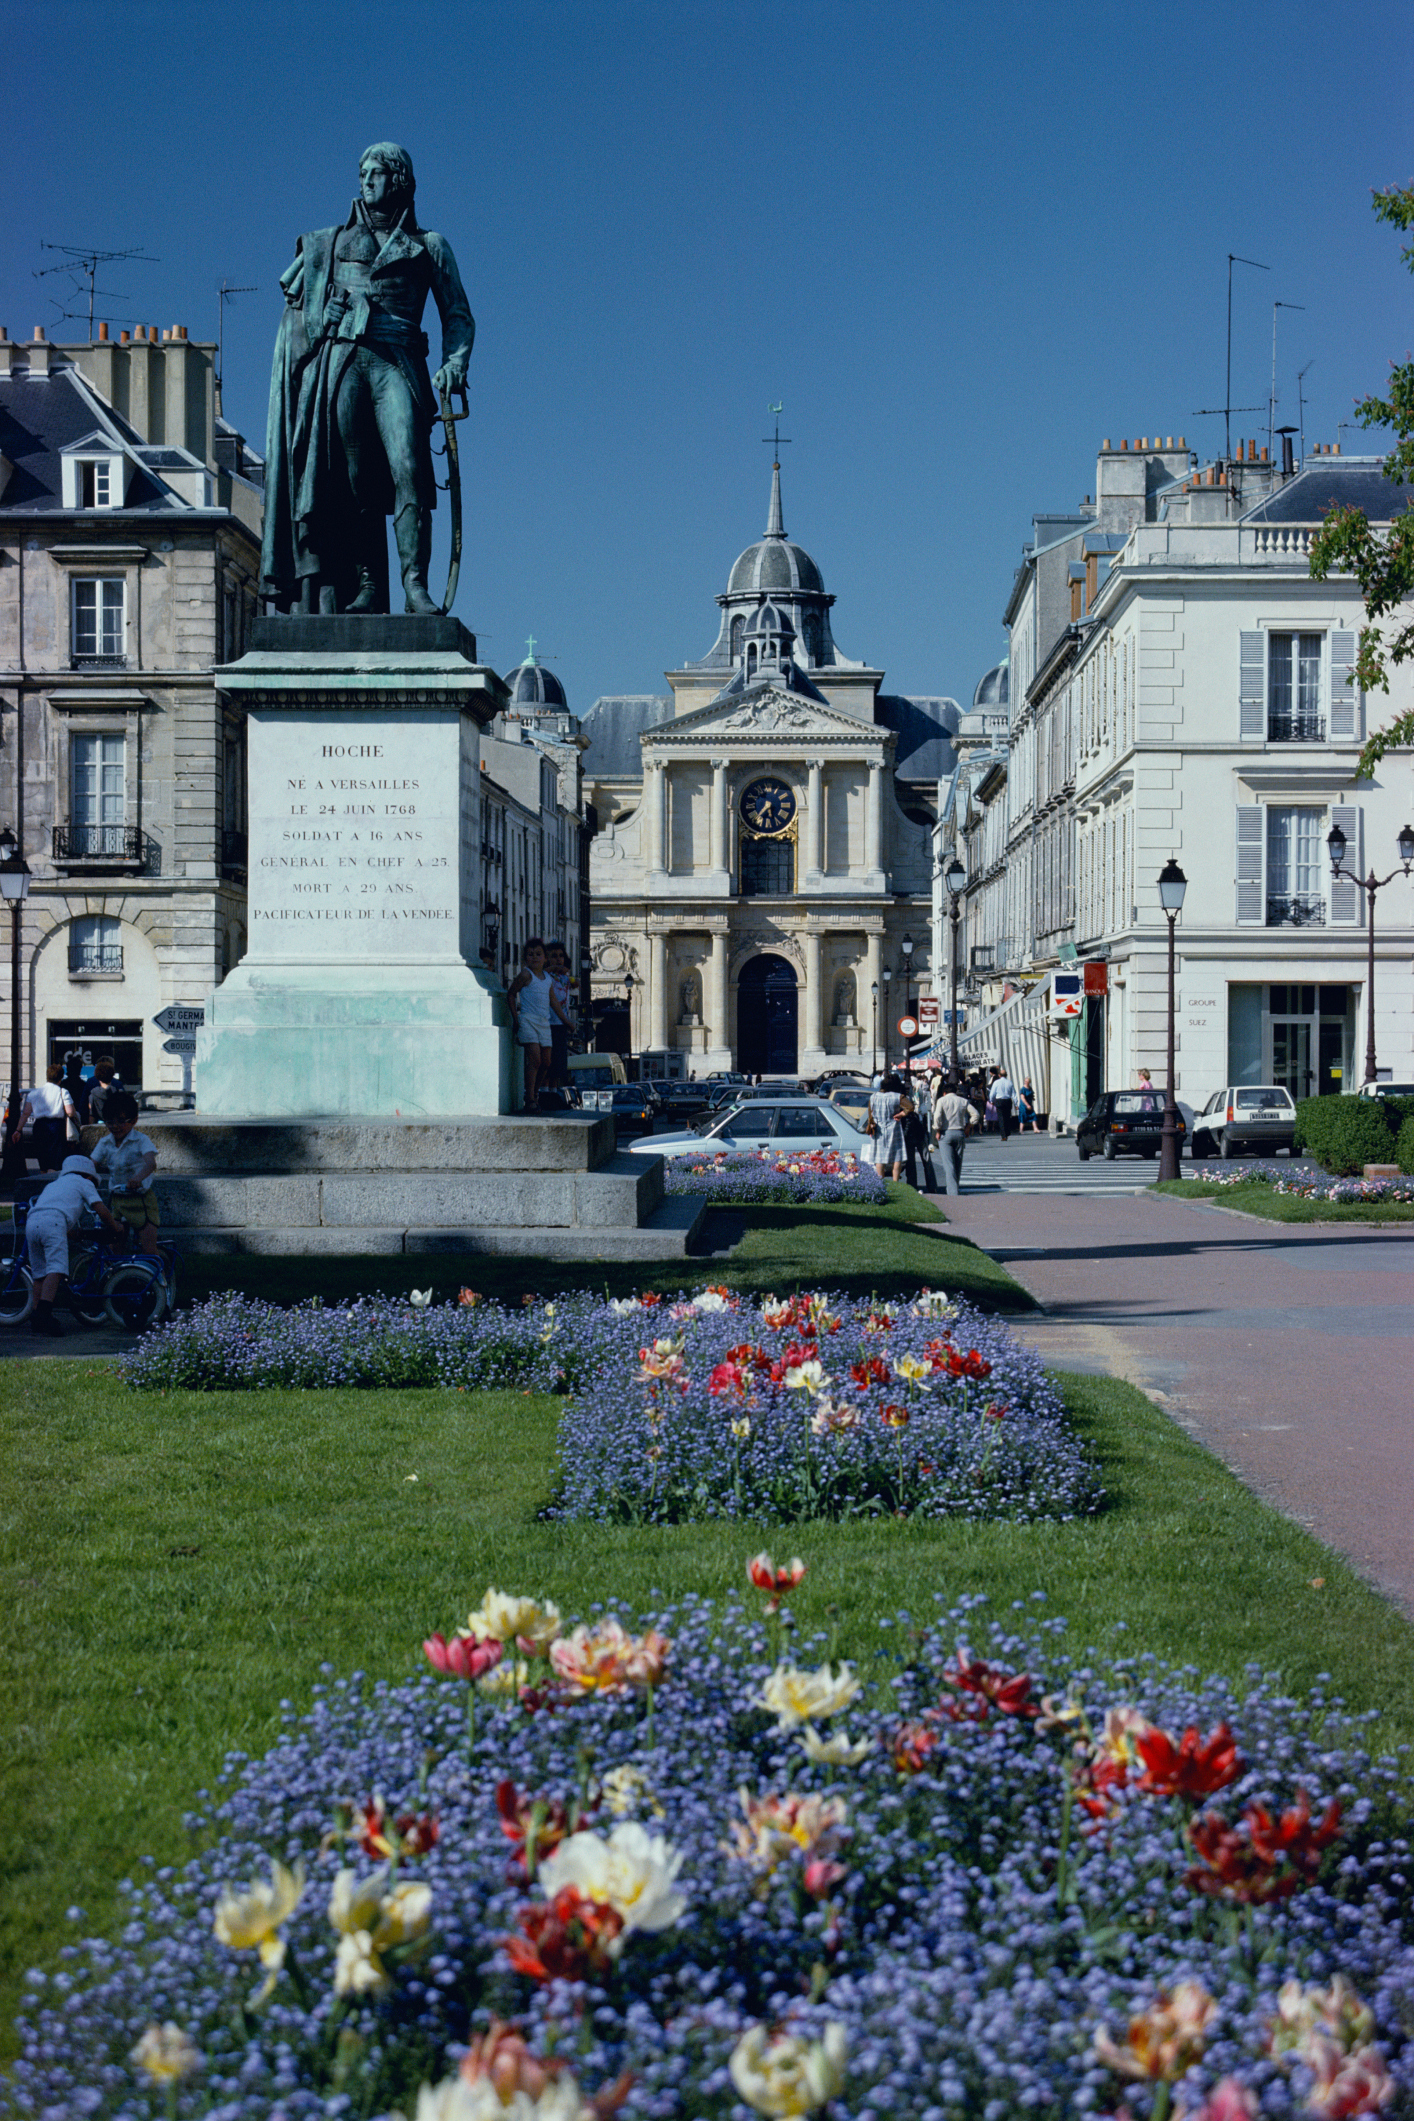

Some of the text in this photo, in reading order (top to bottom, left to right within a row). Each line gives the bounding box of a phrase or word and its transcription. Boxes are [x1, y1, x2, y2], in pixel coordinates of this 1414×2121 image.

[321, 744, 384, 758] HOCHE
[314, 779, 325, 790] A
[329, 779, 420, 790] VERSAILLES
[290, 804, 417, 815] LE 24 JUIN 1768
[282, 830, 423, 841] SOLDAT A 16 ANS
[338, 856, 358, 867] EN
[367, 856, 405, 868] CHEF
[414, 857, 423, 867] A
[292, 883, 332, 893] MORT
[342, 884, 350, 893] A
[360, 883, 377, 893] 29
[253, 909, 353, 920] PACIFICATEUR
[358, 909, 375, 920] DE
[381, 909, 398, 920] LA
[1188, 999, 1217, 1007] GROUPE
[963, 1051, 989, 1061] GLACES
[957, 1057, 996, 1068] CHOCOLATS
